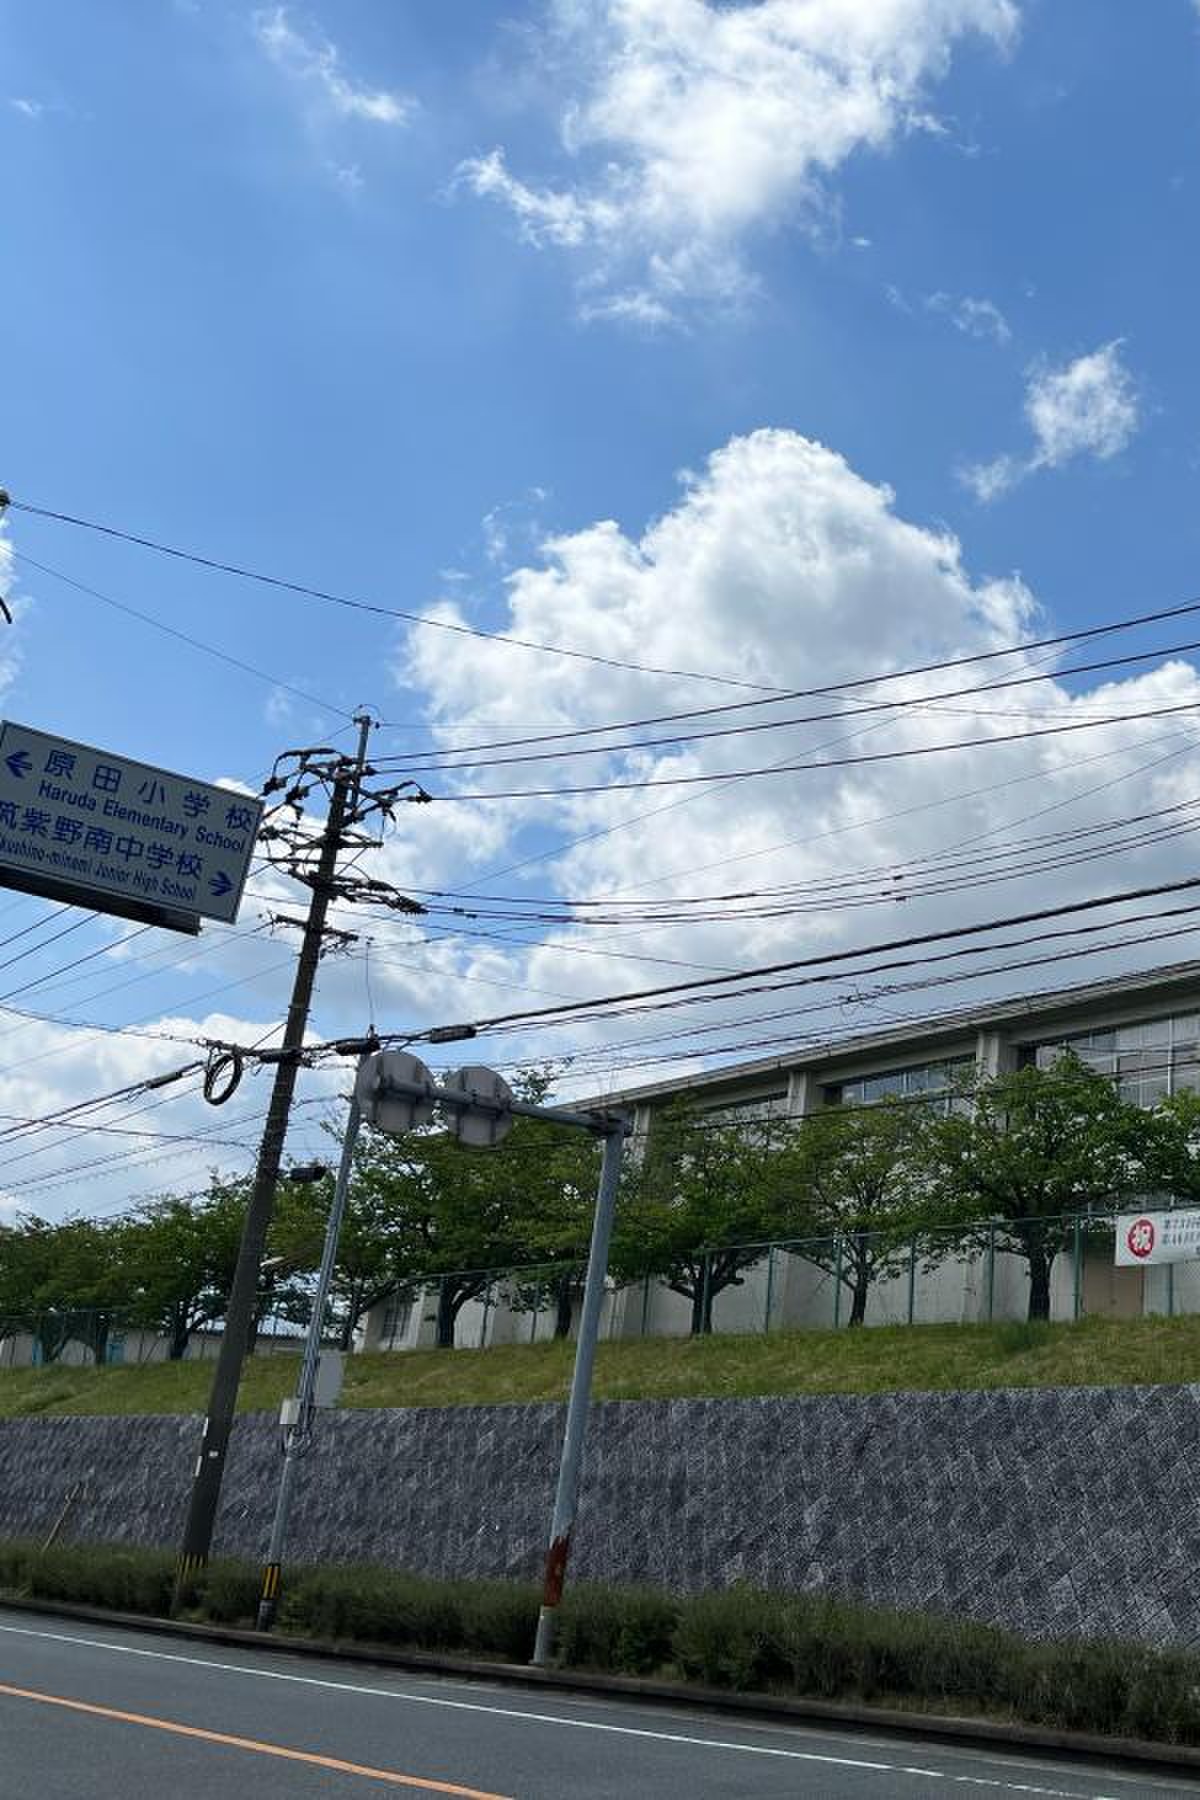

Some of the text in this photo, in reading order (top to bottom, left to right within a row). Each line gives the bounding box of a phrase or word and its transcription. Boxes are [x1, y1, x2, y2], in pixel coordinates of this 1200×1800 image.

[37, 779, 245, 854] Haruda Elementary School
[43, 749, 256, 833] 原田小学校
[0, 799, 204, 881] 筑紫野南中学校
[159, 877, 197, 899] School
